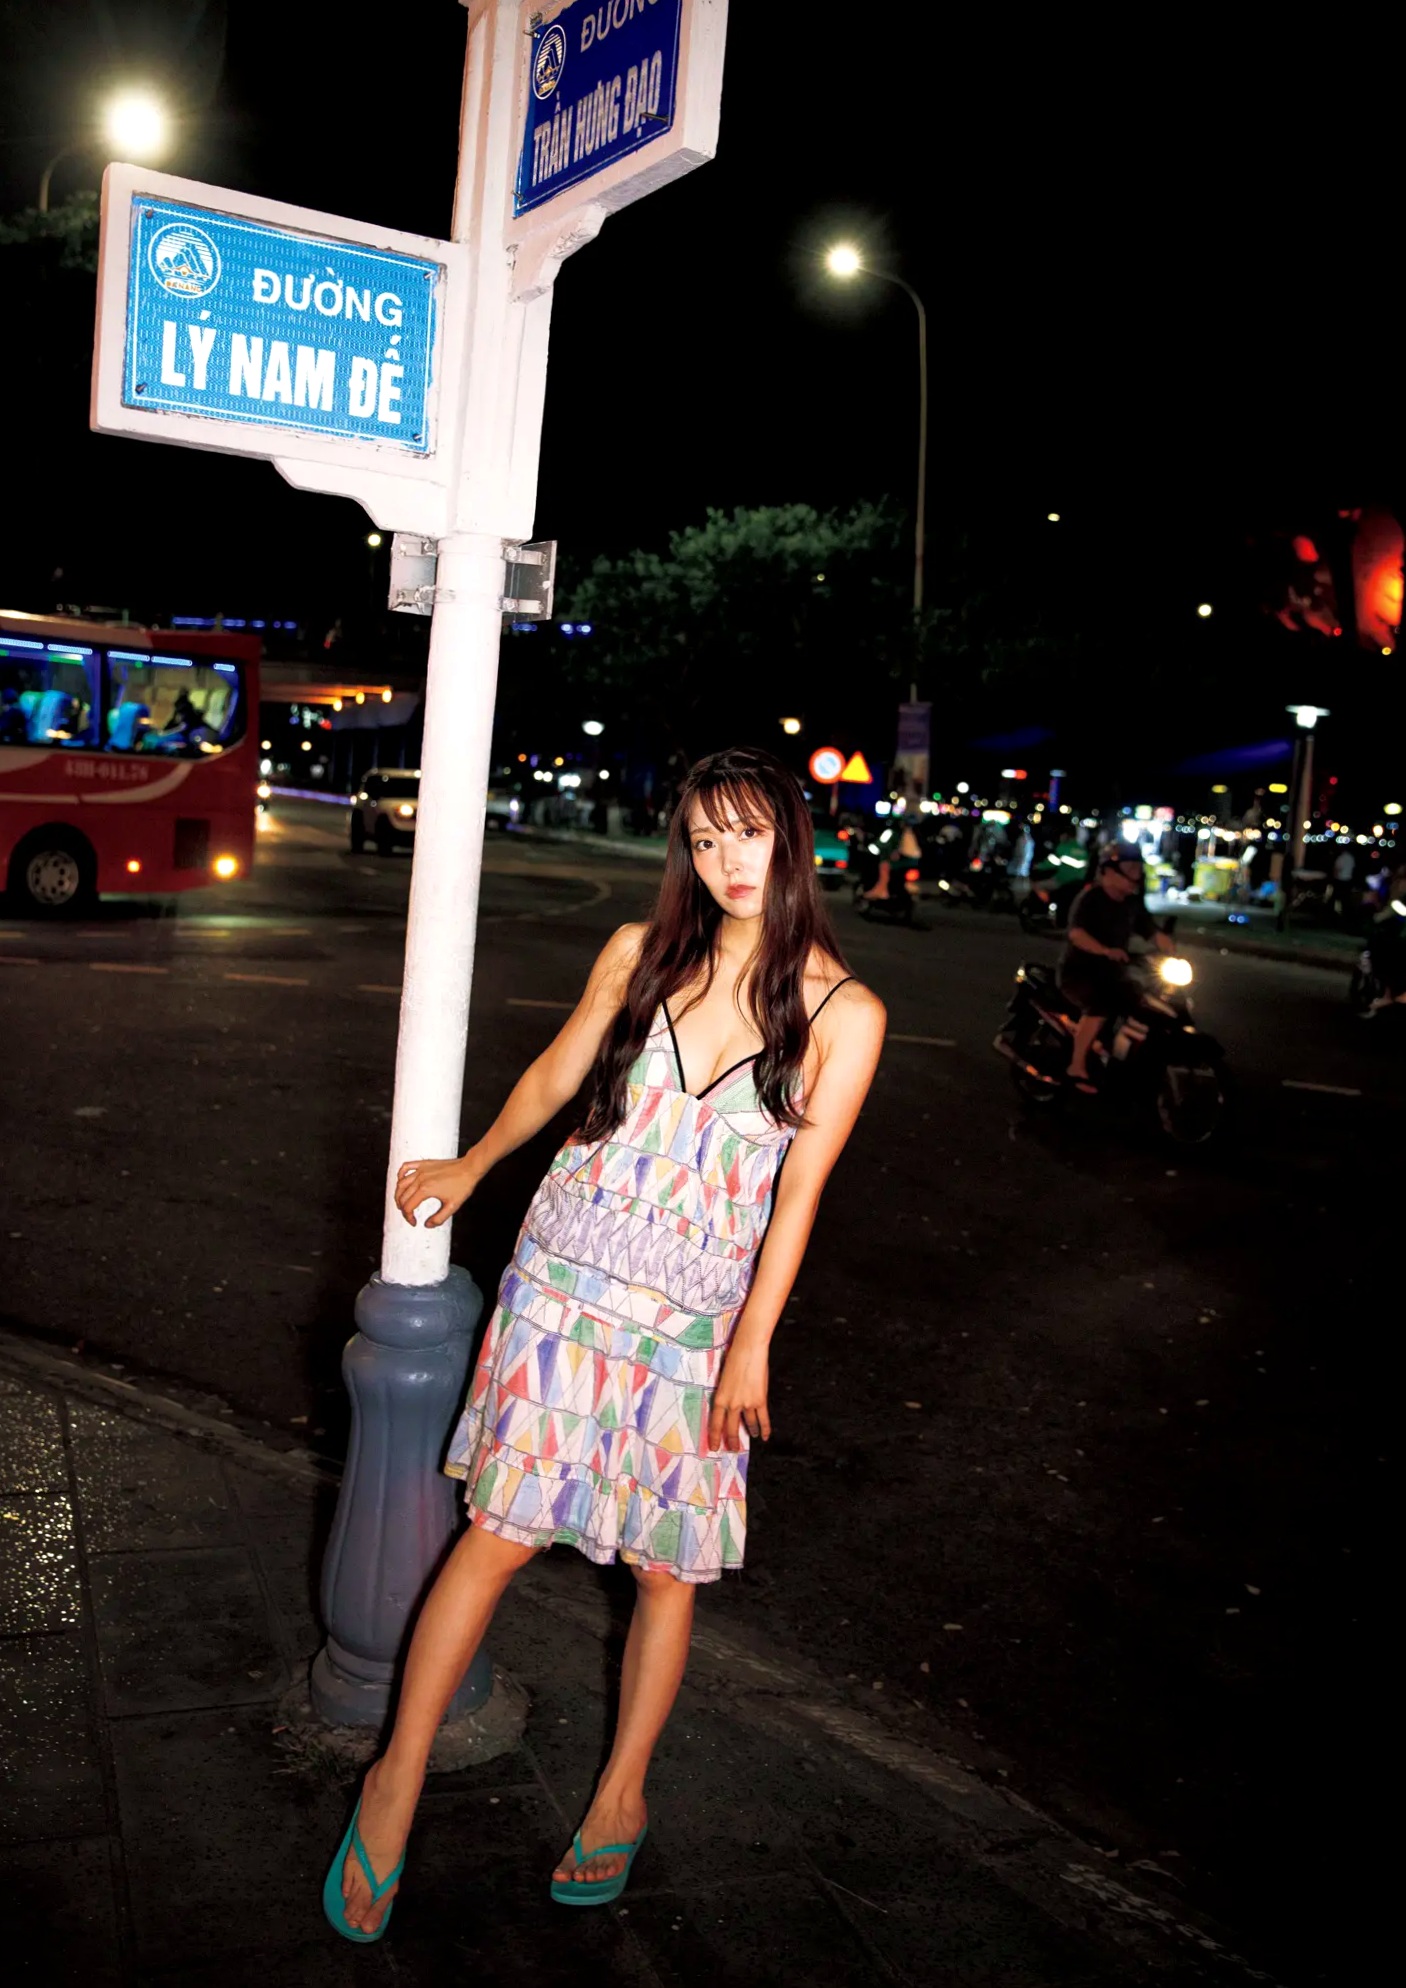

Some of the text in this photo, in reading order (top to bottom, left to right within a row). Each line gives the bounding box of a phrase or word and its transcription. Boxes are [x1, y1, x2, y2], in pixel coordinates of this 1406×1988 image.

[623, 50, 663, 138] ĐẠO
[252, 266, 403, 327] ĐƯỜNG
[160, 310, 404, 425] LÝ NAM ĐẾ
